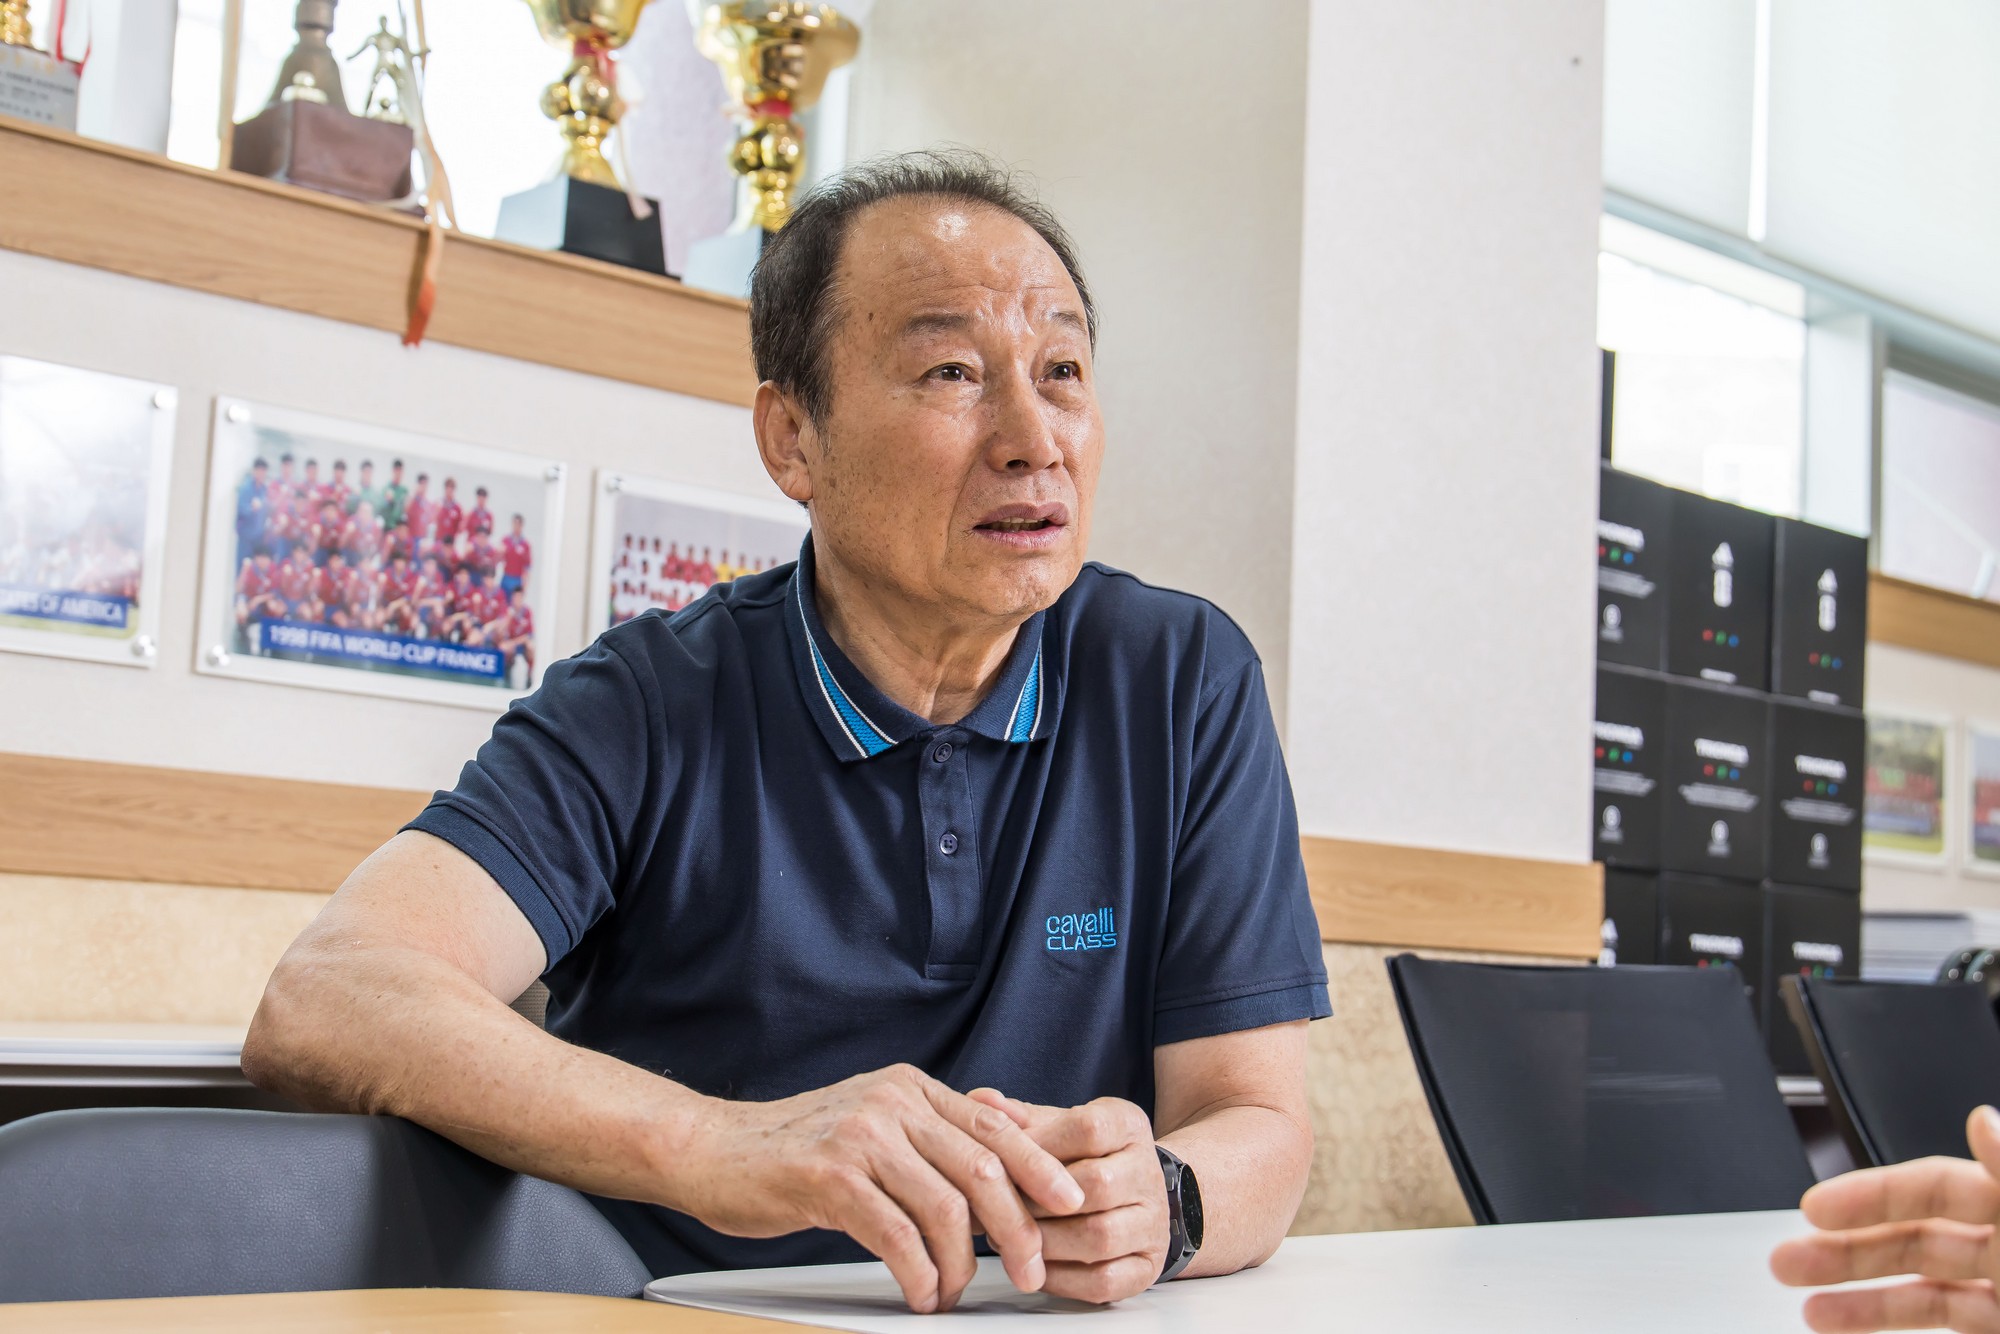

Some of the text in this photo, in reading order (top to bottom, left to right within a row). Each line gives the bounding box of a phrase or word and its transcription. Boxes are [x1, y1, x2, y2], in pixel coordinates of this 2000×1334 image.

[60, 597, 122, 621] AMERICA
[269, 625, 498, 673] 1998 FIFA WORLD CUP FRANCE
[1046, 907, 1114, 935] cavalli
[1046, 932, 1117, 951] CLASS
